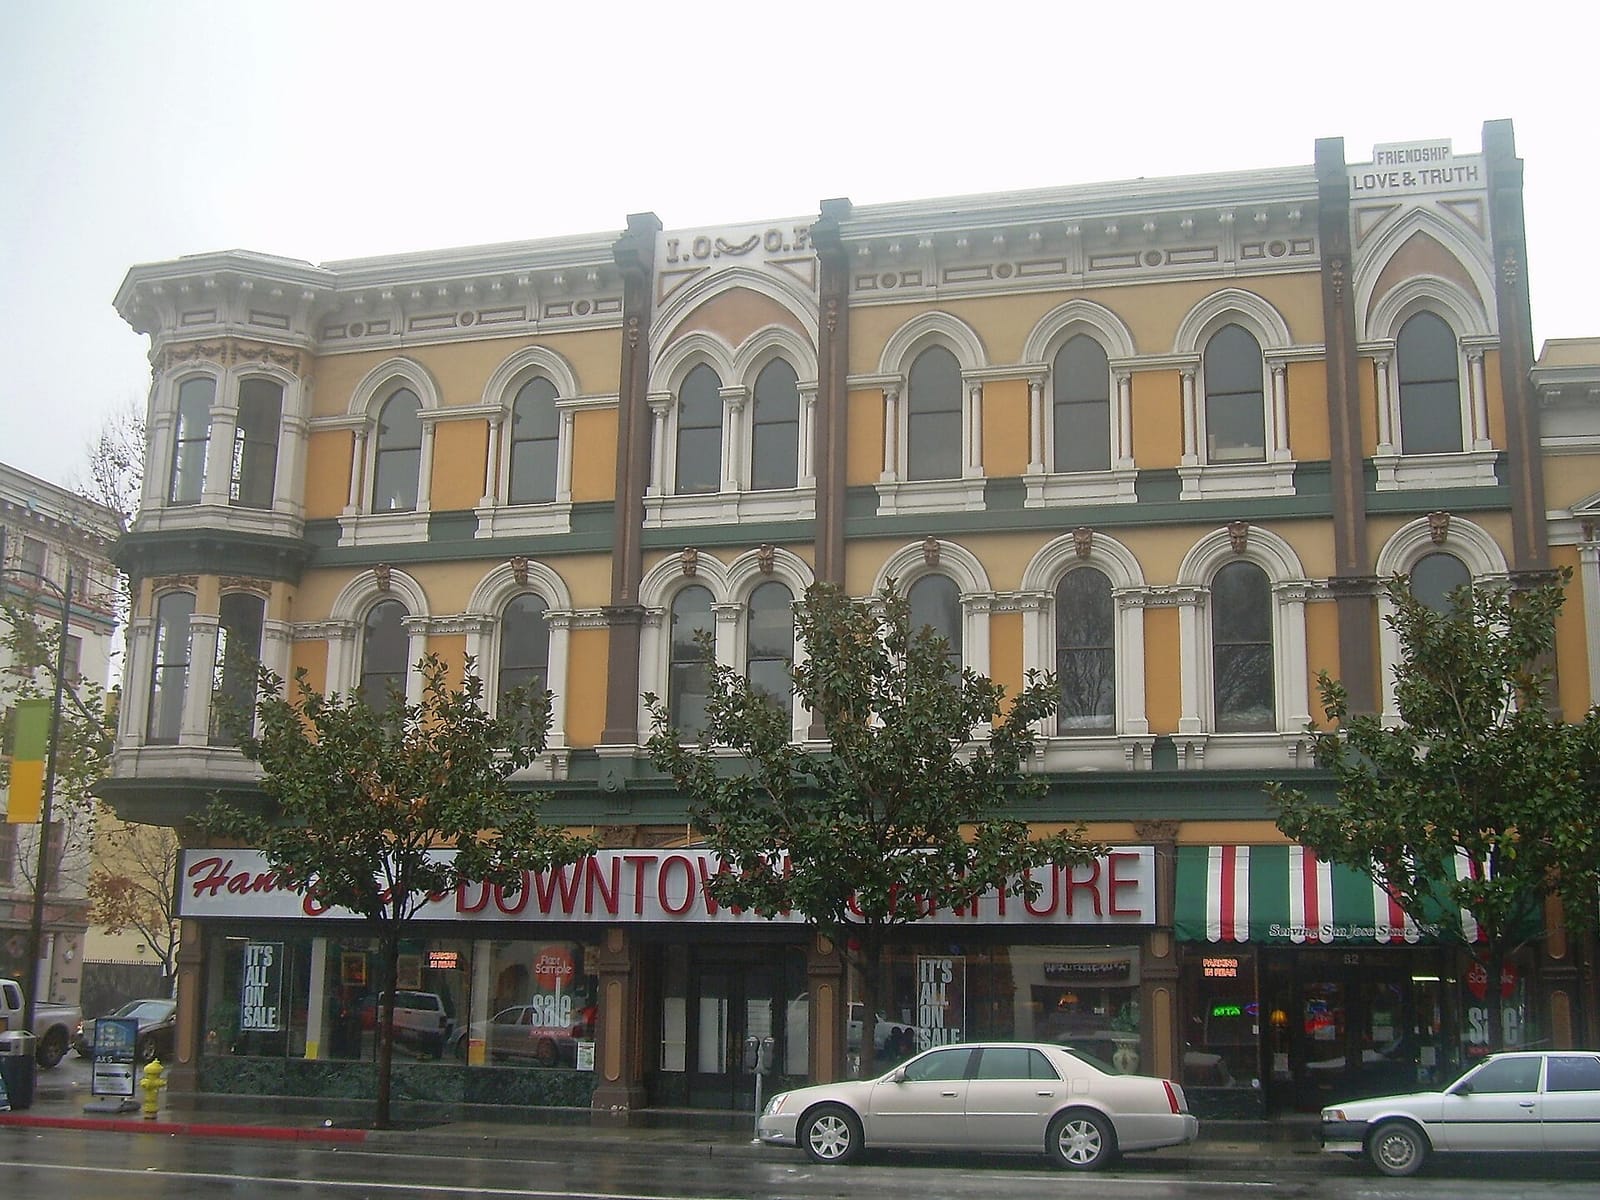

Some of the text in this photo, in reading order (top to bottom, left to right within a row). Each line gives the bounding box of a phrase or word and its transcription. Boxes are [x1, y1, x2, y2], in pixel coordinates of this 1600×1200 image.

[1376, 146, 1449, 166] FRIENDSHIP
[1353, 165, 1478, 190] LOVE & TRUTH
[1269, 924, 1318, 939] Serving
[1319, 924, 1347, 938] San
[1347, 923, 1375, 940] Jose
[1375, 924, 1417, 937] Since
[247, 945, 273, 967] IT'S
[1202, 958, 1239, 968] PARKING
[245, 966, 269, 987] ALL
[535, 960, 573, 975] Sample
[920, 960, 953, 983] IT'S
[1204, 968, 1237, 977] IN REAR
[244, 986, 265, 1008] ON
[920, 983, 950, 1005] ALL
[243, 1006, 276, 1028] SALE
[920, 1005, 944, 1029] ON
